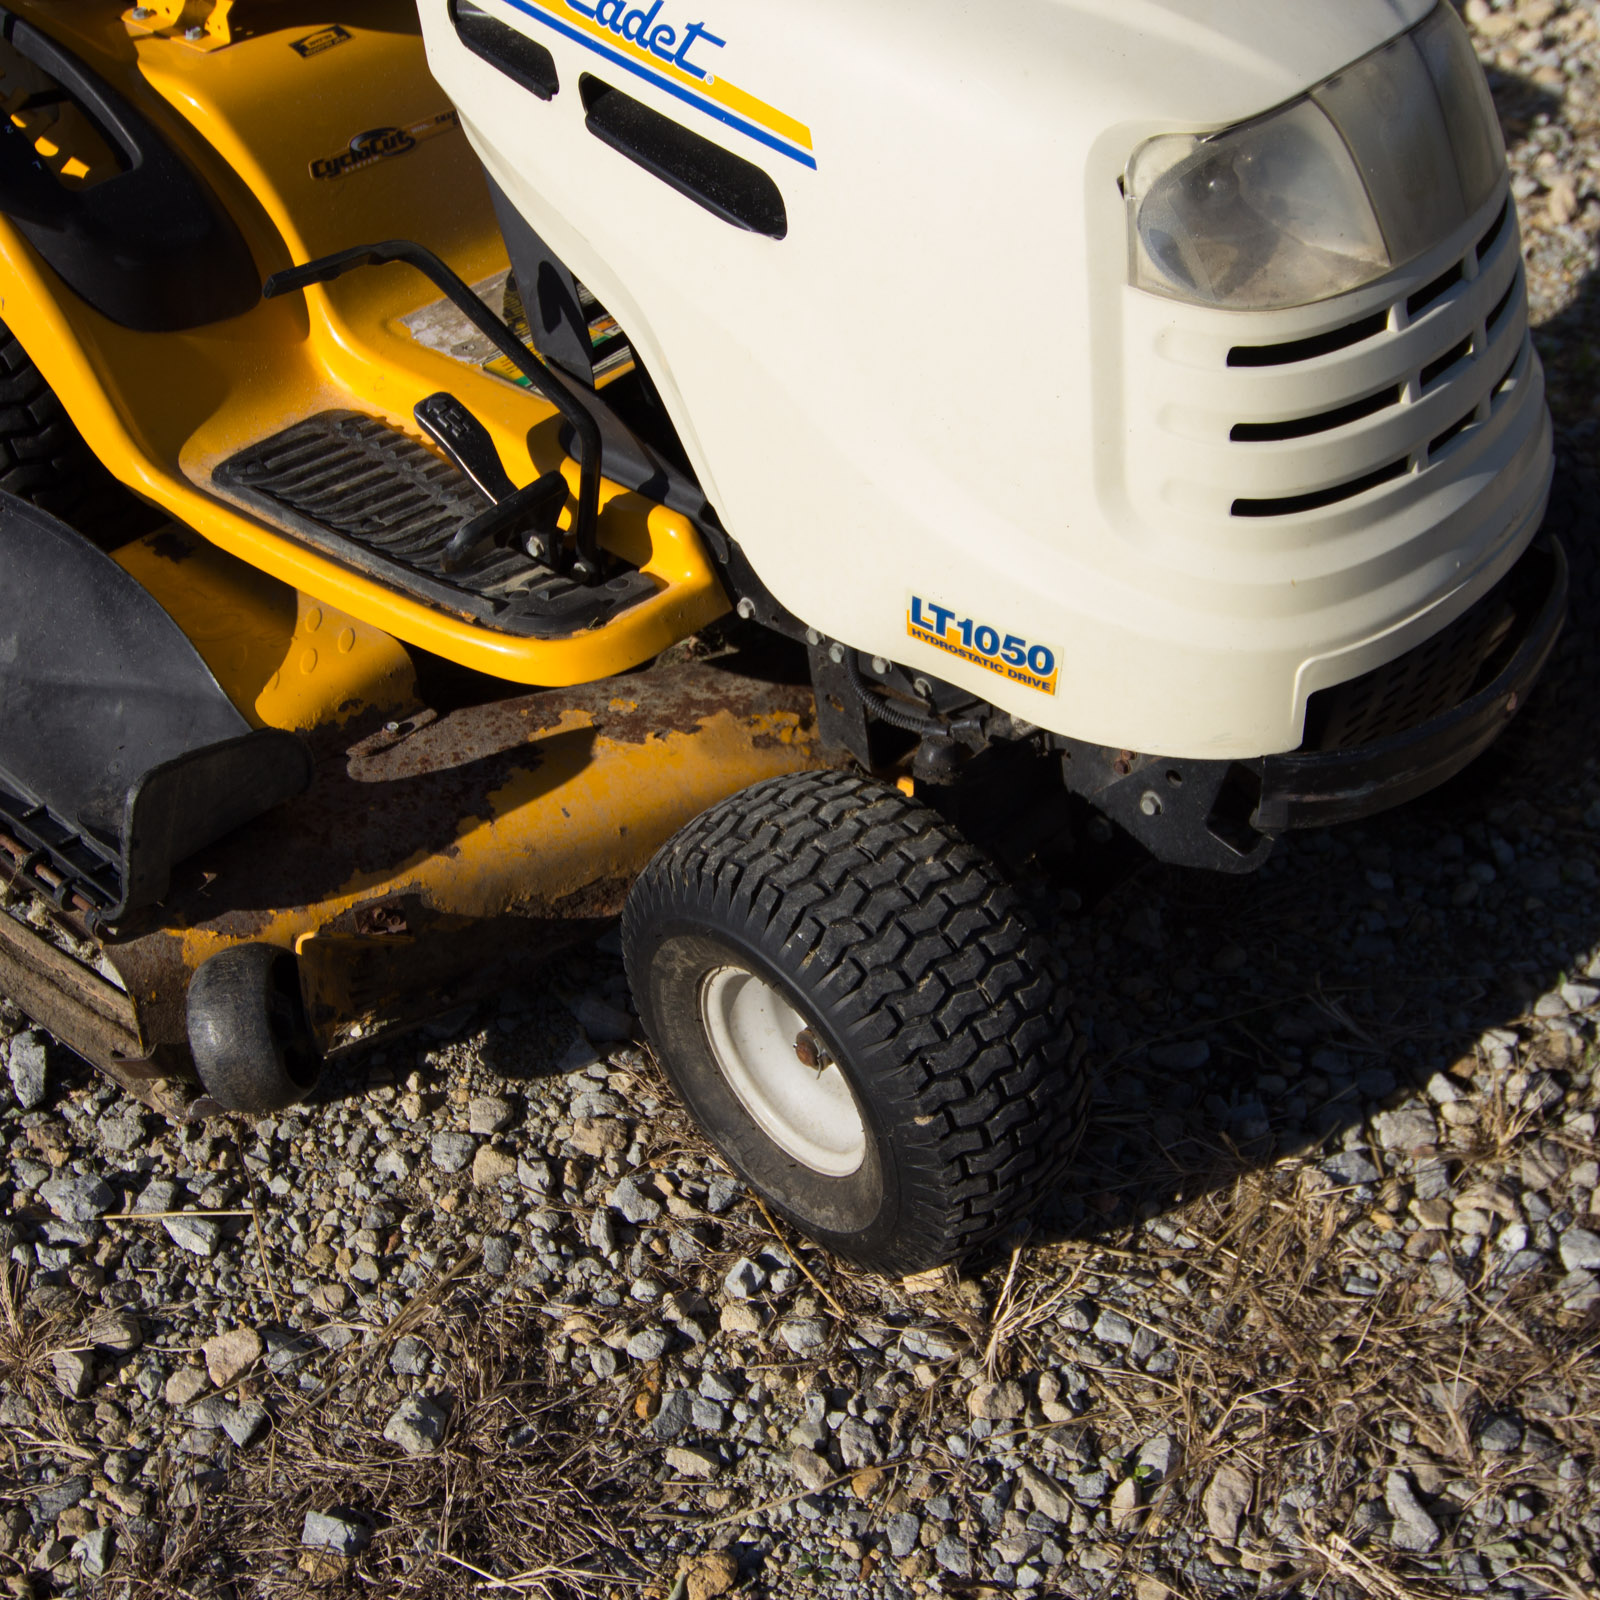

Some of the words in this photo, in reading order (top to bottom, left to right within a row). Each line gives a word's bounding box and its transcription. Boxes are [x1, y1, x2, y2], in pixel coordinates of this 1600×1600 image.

[911, 595, 1055, 676] LT1050
[911, 628, 1004, 674] HYDROSTATIC
[1007, 669, 1051, 692] DRIVE
